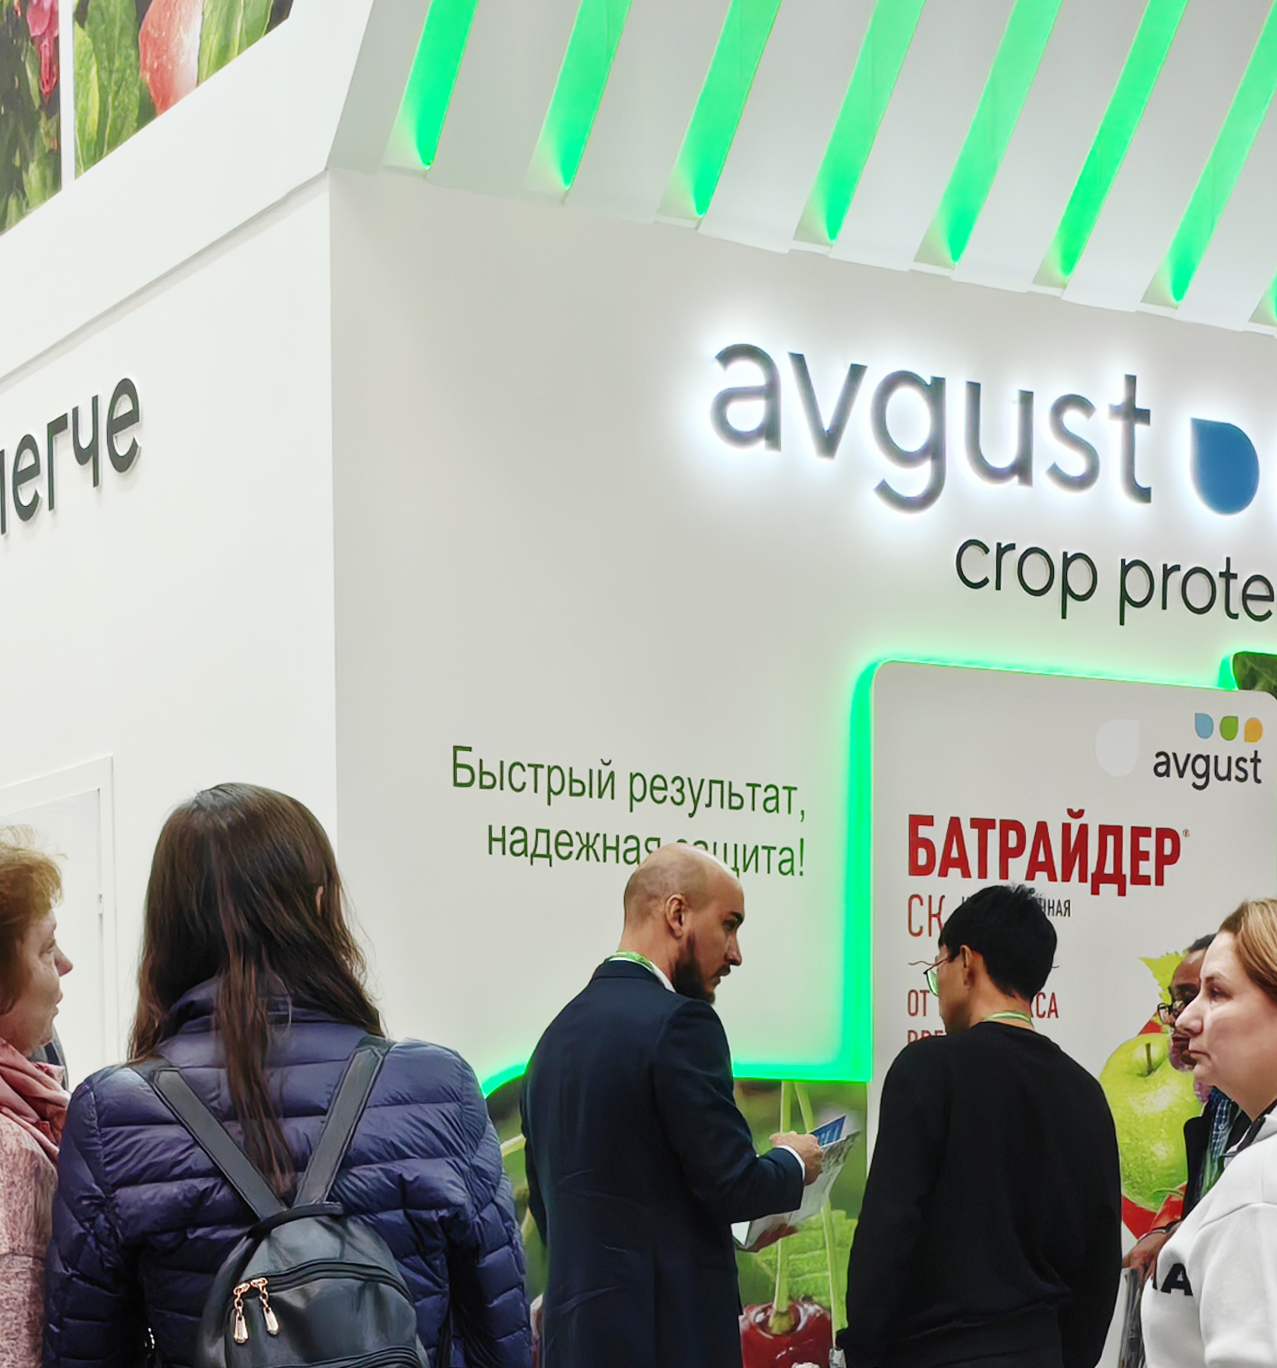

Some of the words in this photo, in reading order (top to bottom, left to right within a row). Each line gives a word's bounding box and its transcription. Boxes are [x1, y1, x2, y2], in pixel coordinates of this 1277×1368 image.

[710, 341, 1152, 514] avgust
[956, 536, 1098, 618] crop
[453, 745, 615, 806] Быстрый
[629, 771, 805, 822] результат,
[1153, 749, 1262, 791] avgust
[675, 837, 805, 879] щита!
[908, 808, 1181, 896] БАТРАЙДЕР
[908, 990, 930, 1016] ОТ
